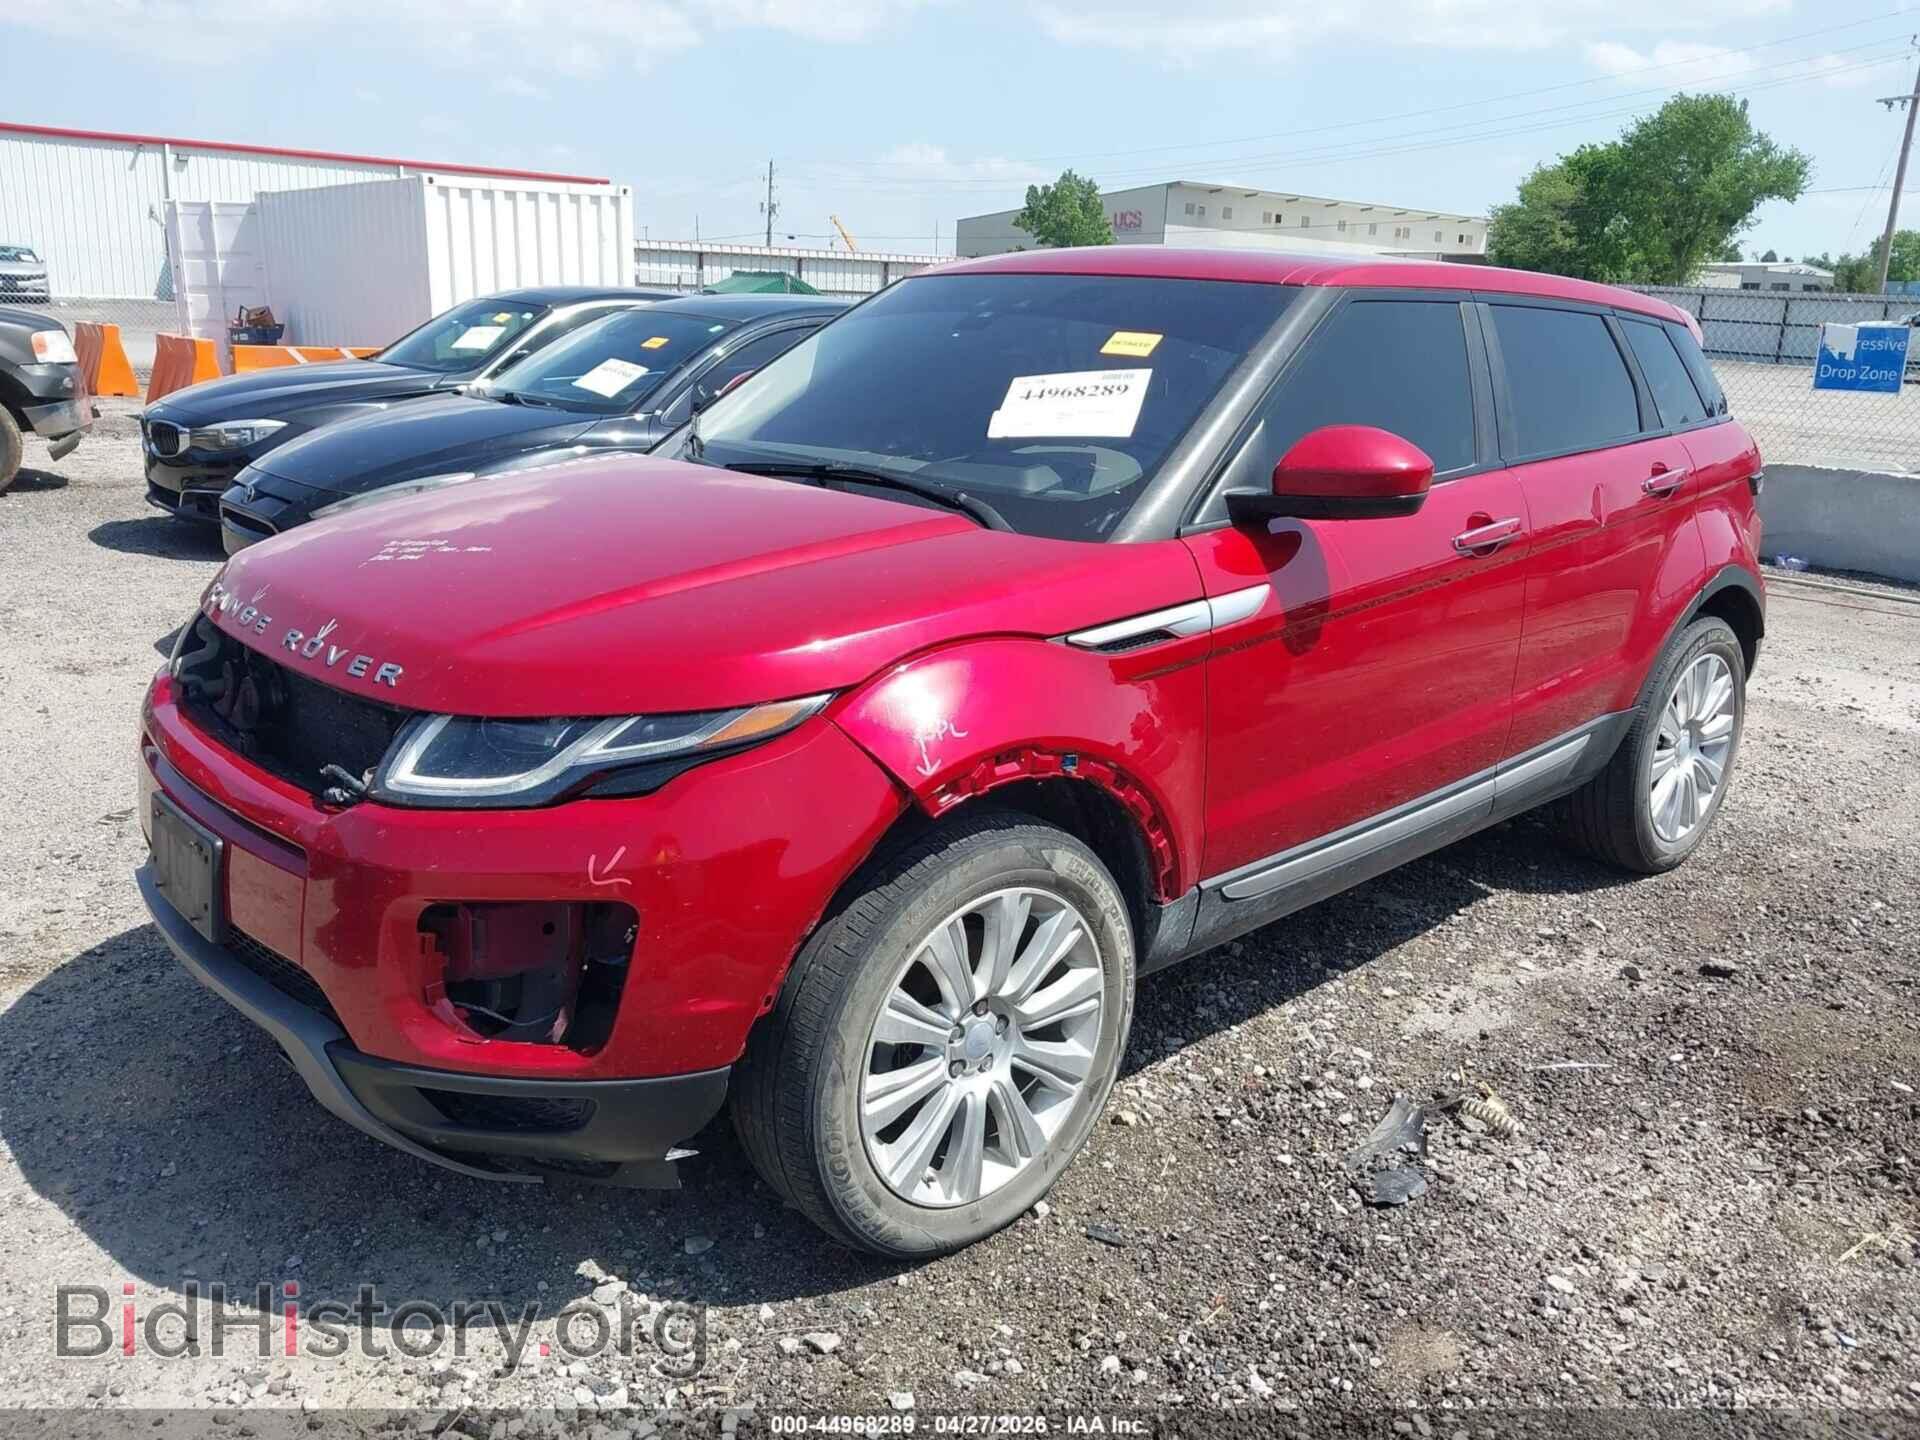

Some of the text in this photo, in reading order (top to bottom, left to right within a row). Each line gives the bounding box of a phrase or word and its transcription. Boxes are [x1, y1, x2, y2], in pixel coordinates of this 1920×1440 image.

[1856, 337, 1907, 352] ressive
[1819, 364, 1898, 381] Drop Zone
[1019, 384, 1129, 401] 44968289
[282, 627, 404, 688] ROVER
